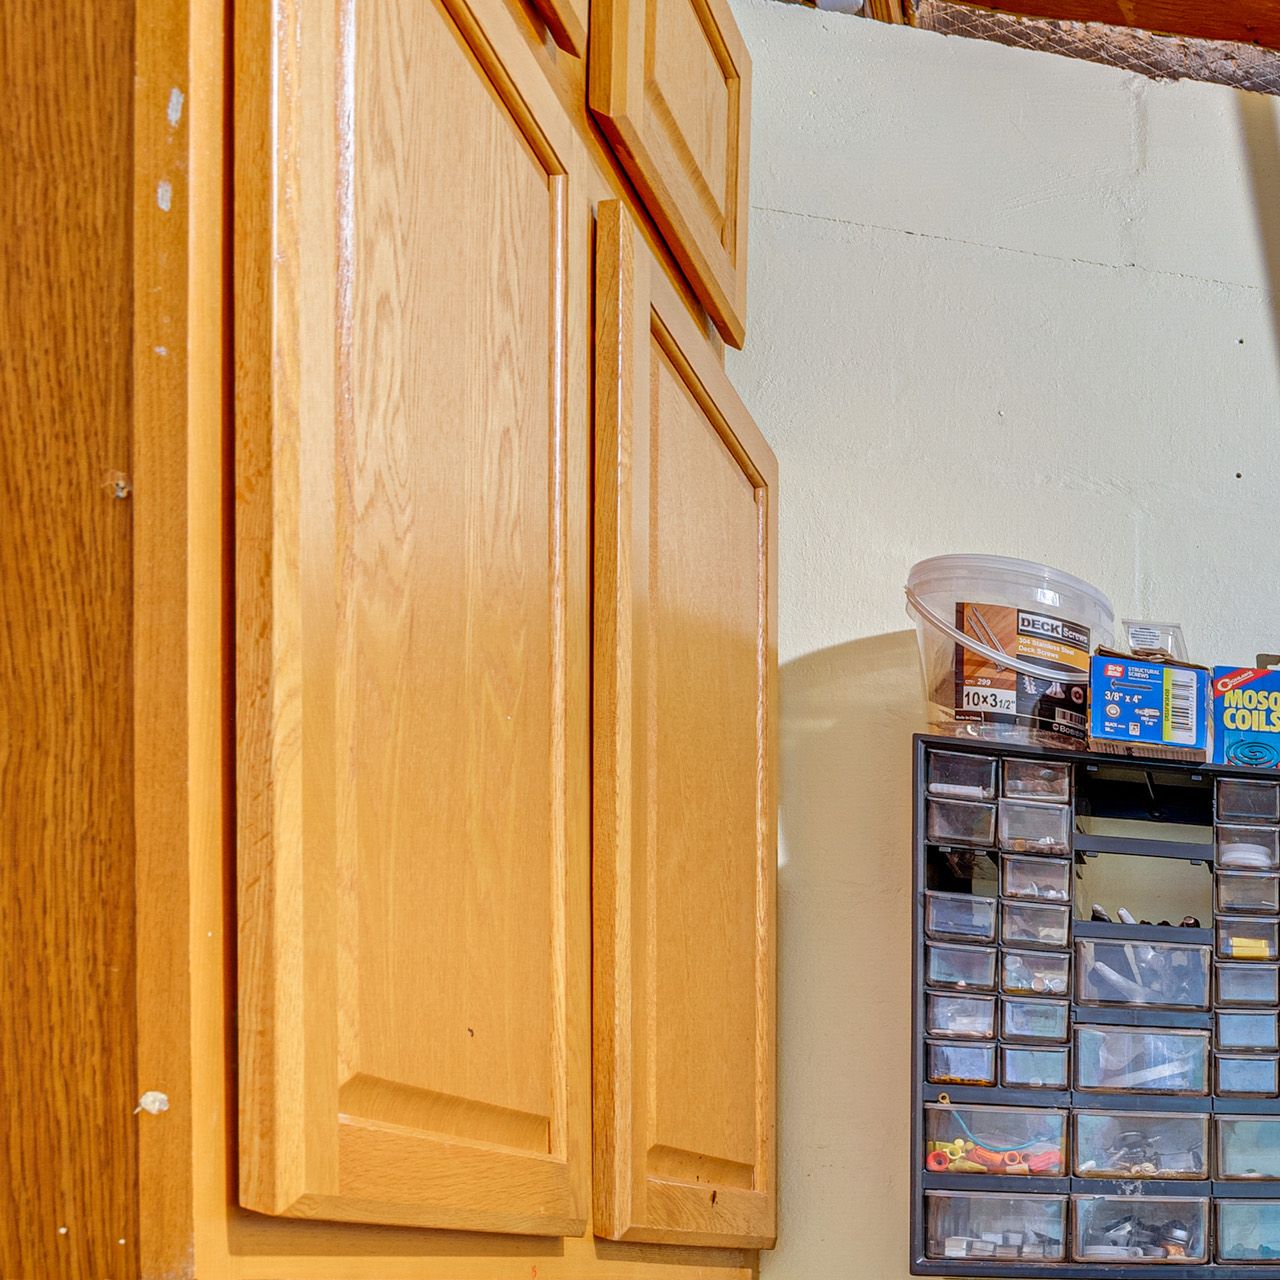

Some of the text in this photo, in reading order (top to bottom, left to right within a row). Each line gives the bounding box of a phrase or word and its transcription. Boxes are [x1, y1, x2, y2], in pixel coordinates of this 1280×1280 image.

[1020, 615, 1088, 644] DECK Screws
[1019, 645, 1059, 659] Deck Screws
[1128, 666, 1161, 675] STRUCTURAL
